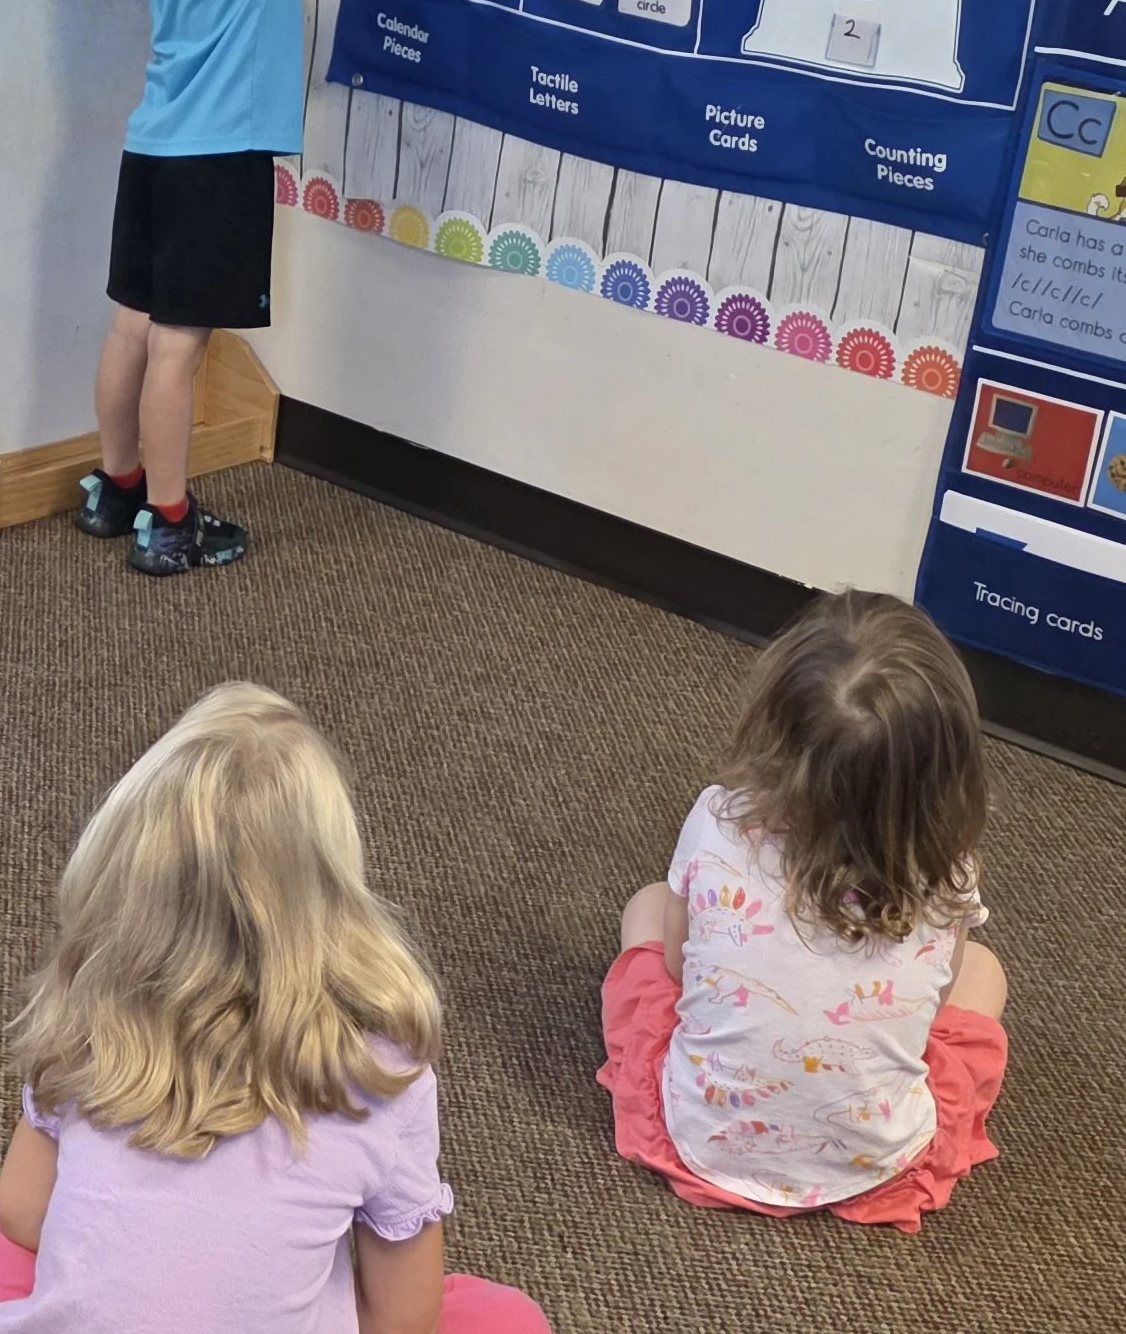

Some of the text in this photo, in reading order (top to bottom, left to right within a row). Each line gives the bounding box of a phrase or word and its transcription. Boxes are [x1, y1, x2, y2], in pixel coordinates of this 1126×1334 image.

[377, 12, 430, 44] Calendar
[843, 19, 861, 40] 2
[383, 36, 422, 63] Pieces
[530, 65, 579, 93] Tactile
[529, 88, 579, 115] Letters
[705, 104, 765, 130] Picture
[1047, 100, 1102, 145] Cc
[709, 129, 758, 152] Cards
[864, 139, 947, 172] Counting
[877, 164, 935, 191] Pieces
[1025, 219, 1071, 245] Carla
[1076, 231, 1105, 252] has
[1019, 245, 1047, 265] she
[1052, 254, 1105, 279] combs
[1008, 300, 1054, 325] Carla
[1059, 313, 1113, 342] combs
[1016, 469, 1080, 494] computer
[974, 580, 1104, 641] Tracing cards
